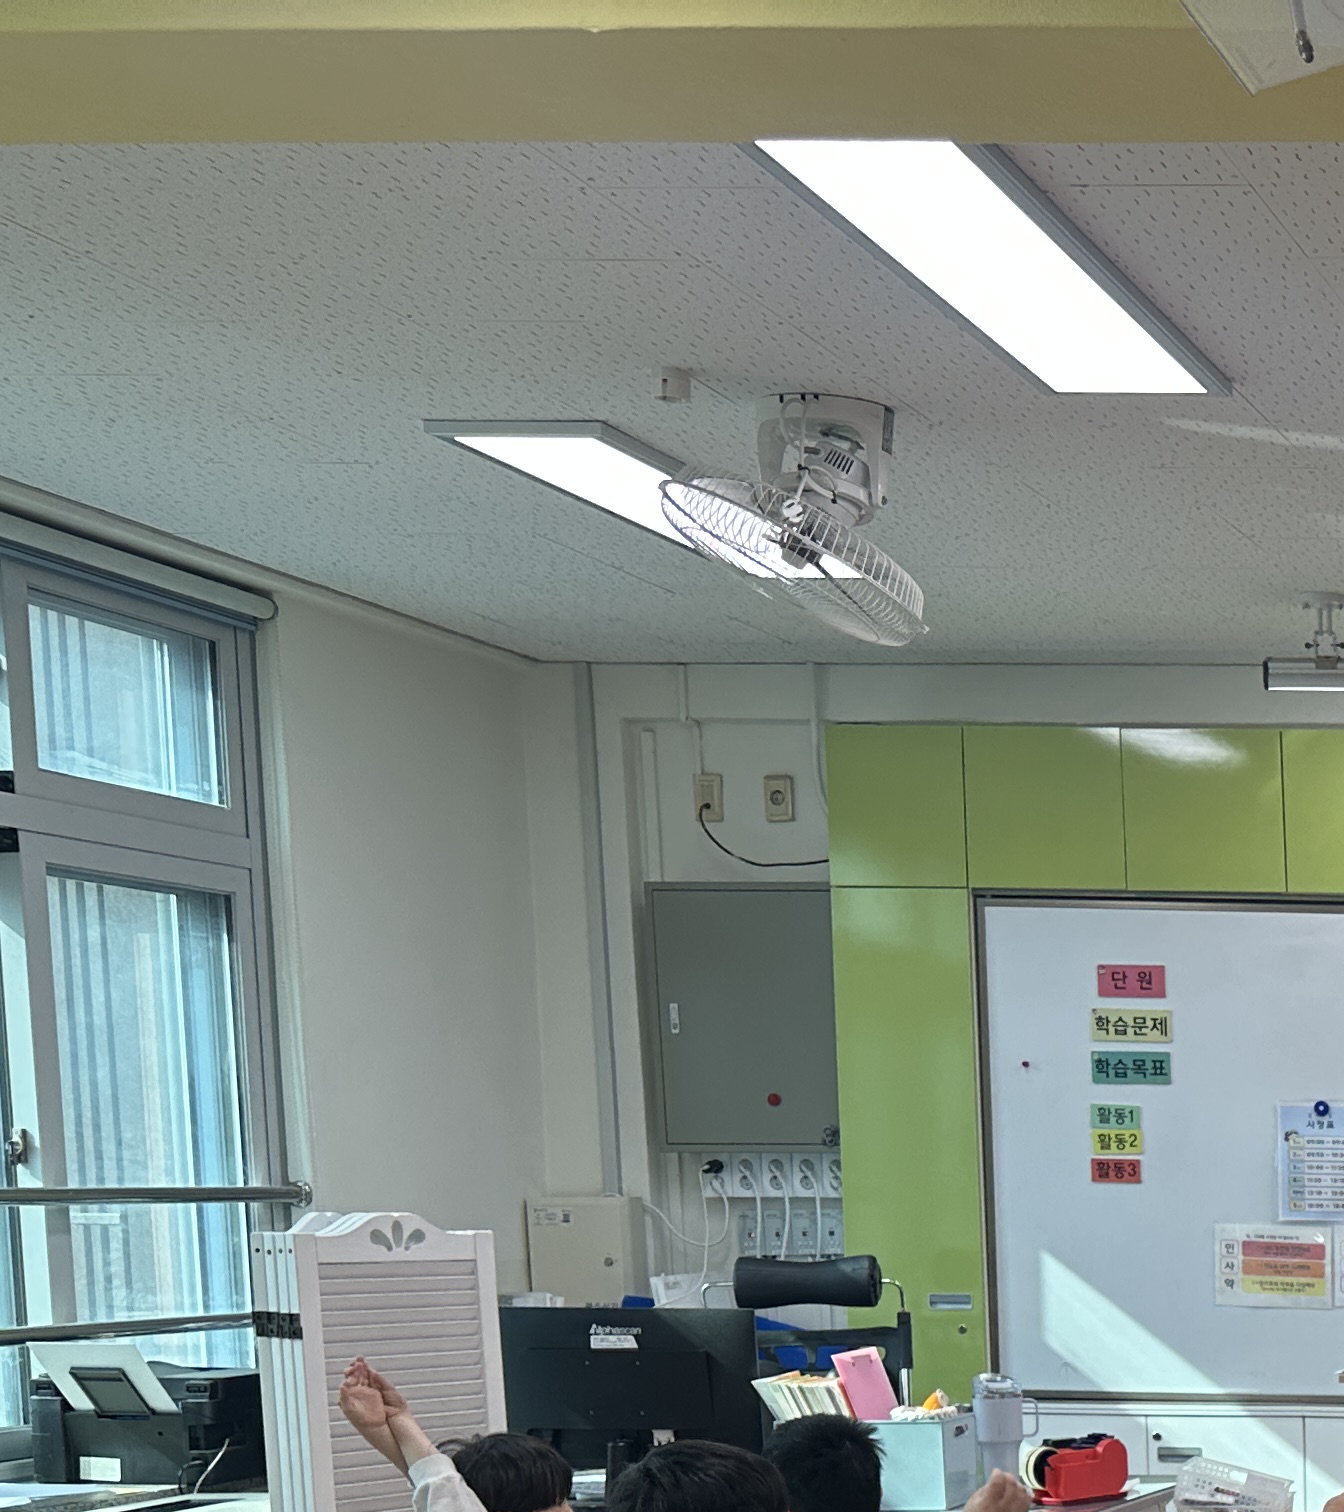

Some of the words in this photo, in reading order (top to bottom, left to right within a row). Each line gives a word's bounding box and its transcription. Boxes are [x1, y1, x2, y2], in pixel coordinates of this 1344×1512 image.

[1095, 1015, 1167, 1037] 학습문제
[1095, 1058, 1168, 1079] 학습목표
[1096, 1107, 1134, 1125] 활동1
[1097, 1133, 1138, 1150] 활동2
[1096, 1161, 1136, 1179] 활동3
[1225, 1243, 1235, 1254] 인
[1224, 1261, 1235, 1271] 사
